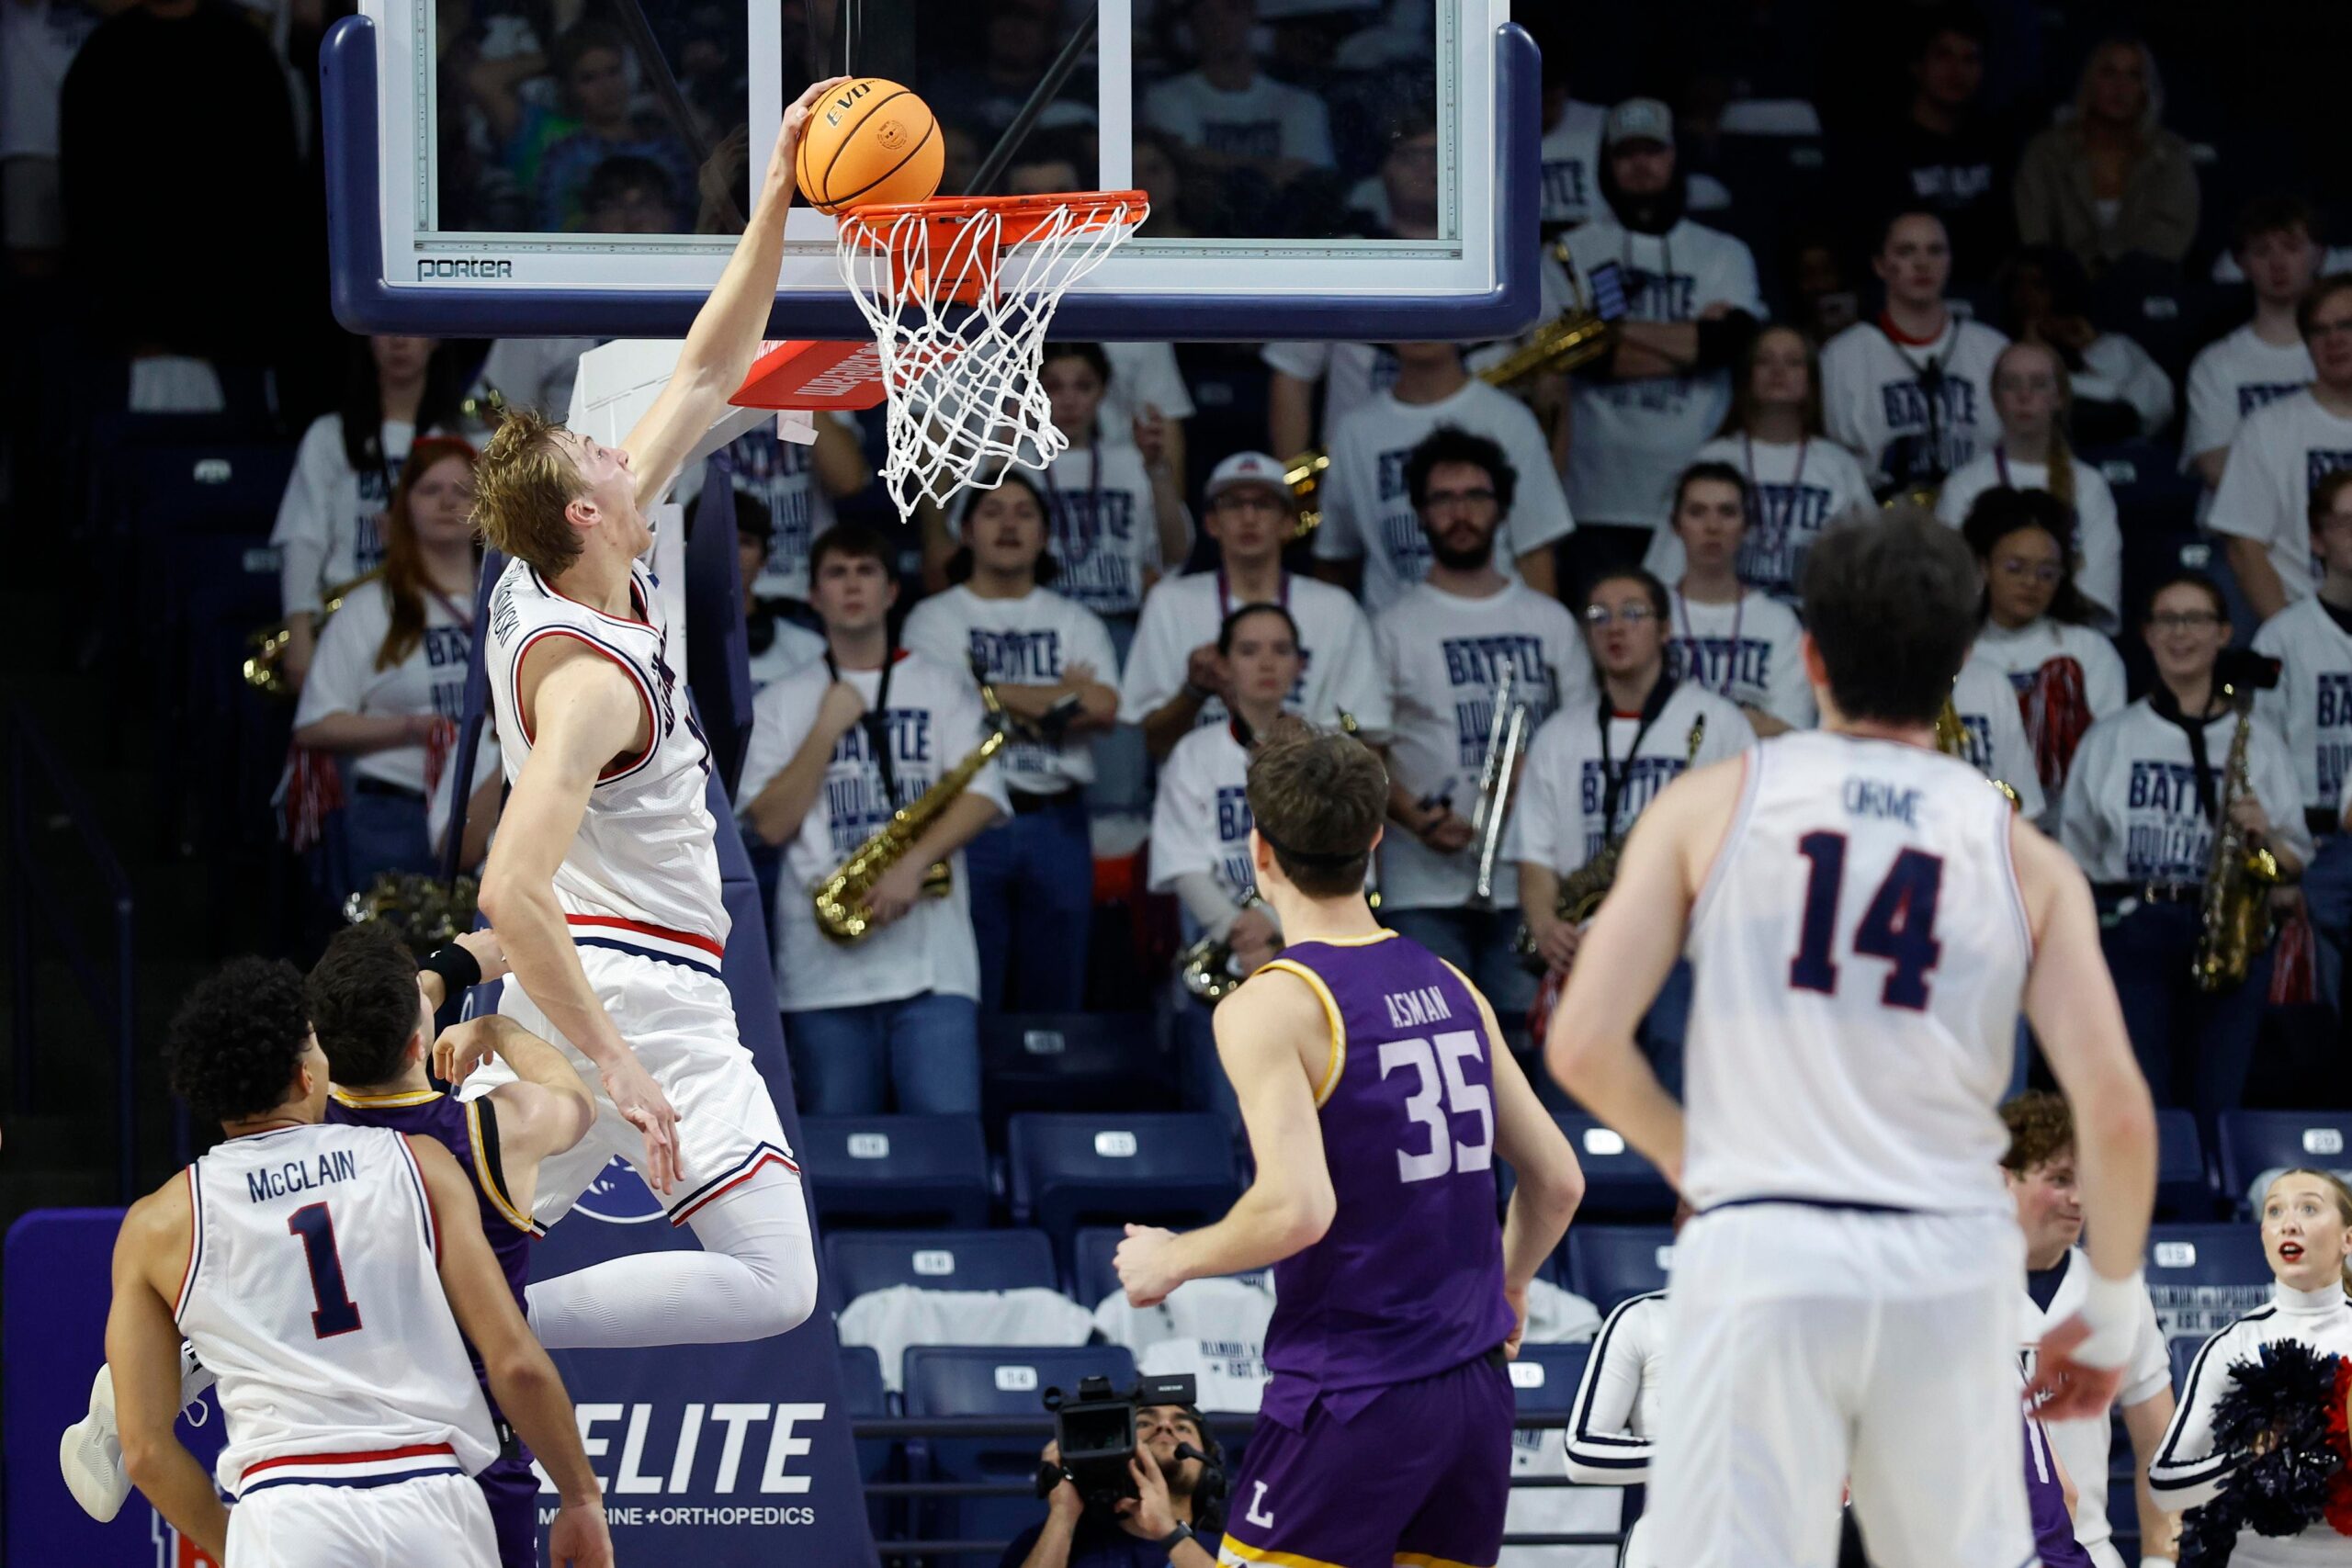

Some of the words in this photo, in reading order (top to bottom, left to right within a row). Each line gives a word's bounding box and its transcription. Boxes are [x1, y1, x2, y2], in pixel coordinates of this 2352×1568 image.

[826, 83, 871, 127] EVO
[1789, 826, 1946, 1013] 14
[1384, 985, 1453, 1029] ASMAN
[1378, 1029, 1495, 1184] 35
[288, 1201, 363, 1339] 1
[564, 1403, 826, 1494] ELITE
[1244, 1479, 1274, 1529] L
